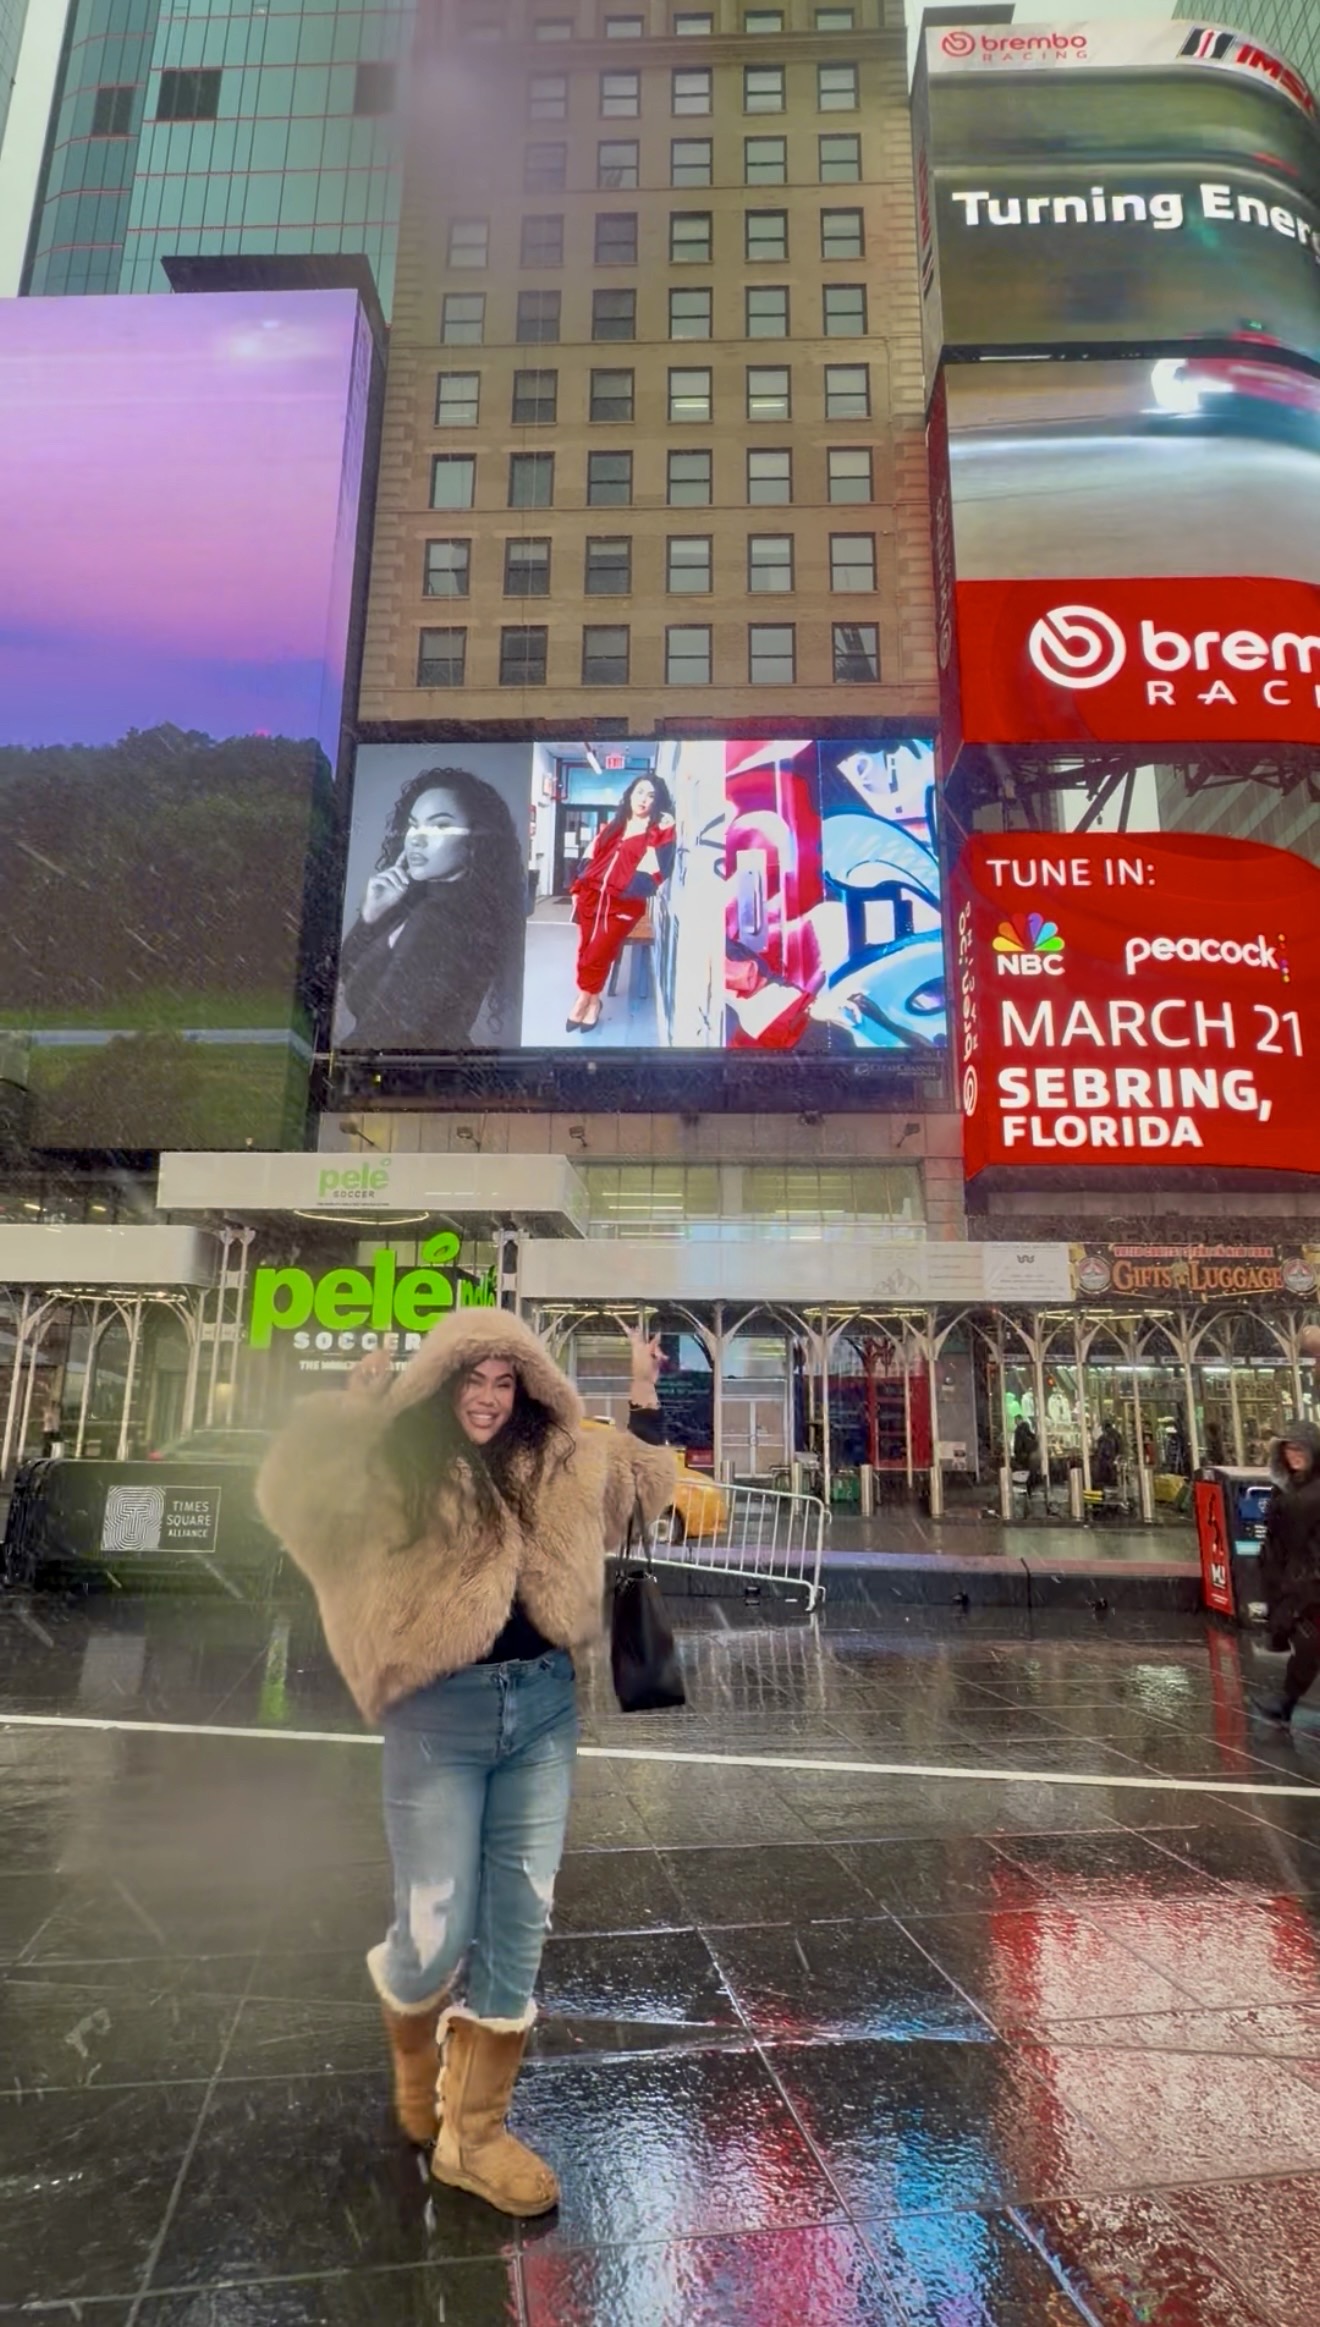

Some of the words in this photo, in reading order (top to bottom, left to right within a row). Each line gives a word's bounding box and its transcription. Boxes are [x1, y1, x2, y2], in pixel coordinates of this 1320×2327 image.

[981, 33, 1087, 51] brembo
[983, 50, 1088, 61] RACING
[952, 187, 1184, 229] Turning
[986, 858, 1092, 887] TUNE
[1105, 858, 1156, 886] IN:
[997, 954, 1066, 976] NBC
[1125, 934, 1279, 975] peacock
[1001, 999, 1236, 1049] MARCH
[1253, 1004, 1304, 1057] 21
[998, 1067, 1273, 1122] SEBRING,
[1002, 1115, 1205, 1148] FLORIDA
[333, 1190, 375, 1199] SOCCER
[1112, 1260, 1173, 1291] GIFTS
[1188, 1259, 1284, 1292] LUGGAGE
[249, 1231, 462, 1350] pelé
[293, 1331, 421, 1351] SOCCER
[166, 1514, 211, 1527] SQUARE
[173, 1501, 209, 1513] TIMES
[168, 1528, 208, 1538] ALLIANCE
